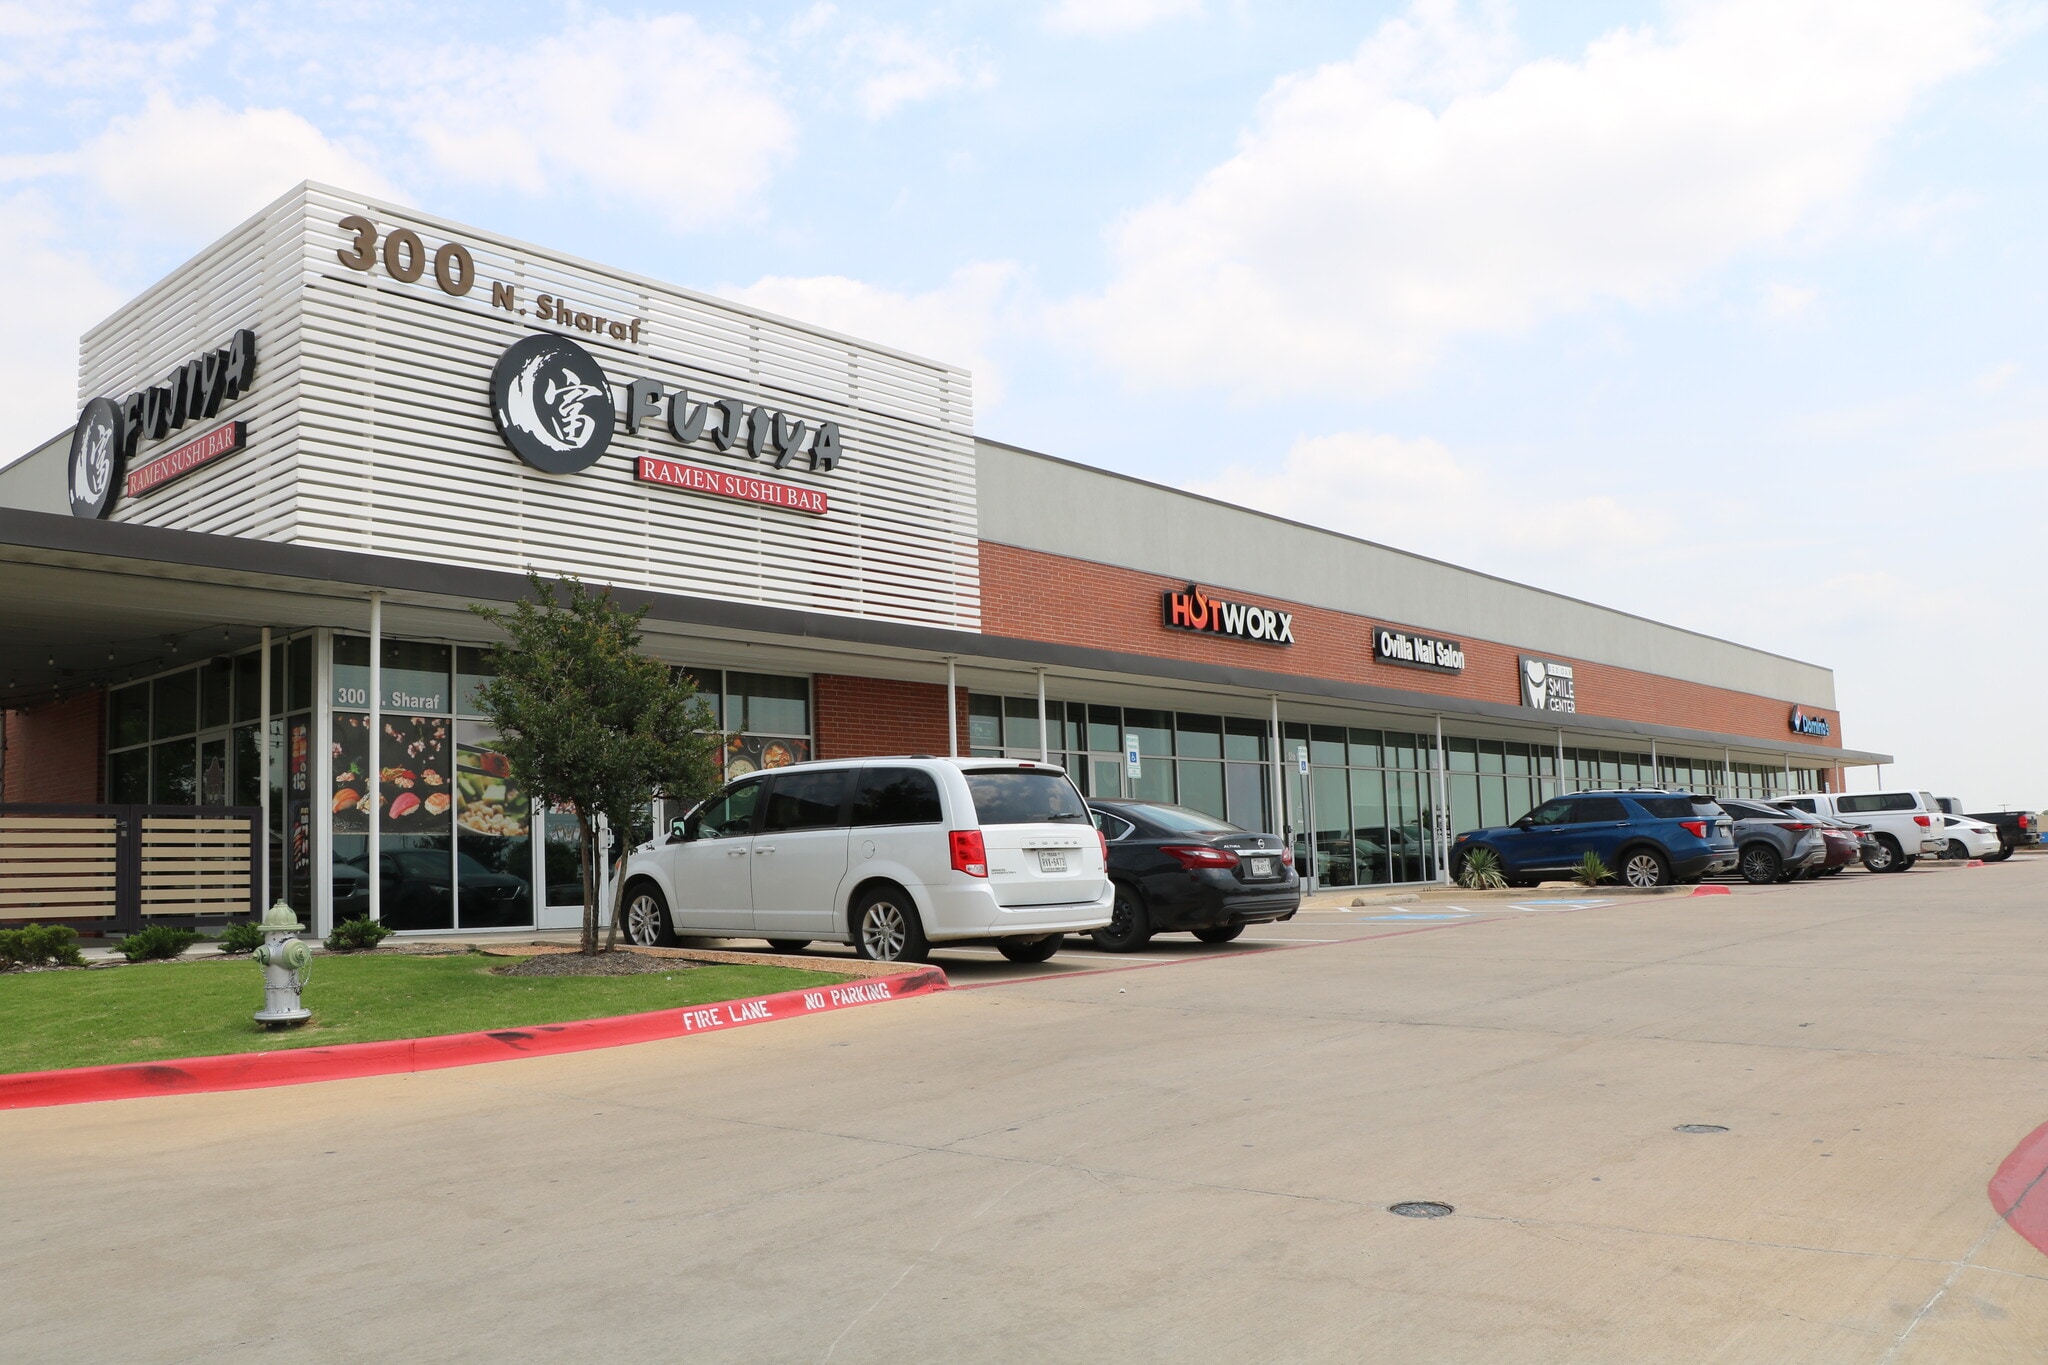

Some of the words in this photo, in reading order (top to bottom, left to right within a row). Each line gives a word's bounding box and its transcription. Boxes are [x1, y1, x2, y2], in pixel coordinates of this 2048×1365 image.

[337, 215, 475, 297] 300
[492, 280, 527, 316] N.
[536, 293, 642, 344] Sharaf
[123, 329, 257, 458] FUJIYA
[625, 376, 844, 473] FUJIYA
[129, 460, 169, 494] RAMEN
[171, 443, 206, 474] SUSHI
[208, 426, 233, 456] BAR
[643, 460, 720, 492] RAMEN
[725, 476, 782, 504] SUSHI
[787, 487, 824, 512] BAR
[1171, 584, 1295, 643] HOTWORX
[1381, 631, 1413, 661] Ovilla
[1414, 637, 1436, 665] Nail
[1436, 641, 1465, 669] Salon
[338, 687, 366, 705] 300
[392, 691, 440, 710] Sharaf
[1548, 677, 1575, 699] SMILE
[1549, 698, 1576, 714] CENTER
[1802, 714, 1830, 737] Domino's
[683, 1008, 724, 1031] FIRE
[728, 1000, 772, 1023] LANE
[804, 992, 826, 1010] NO
[831, 982, 892, 1006] PARKING
